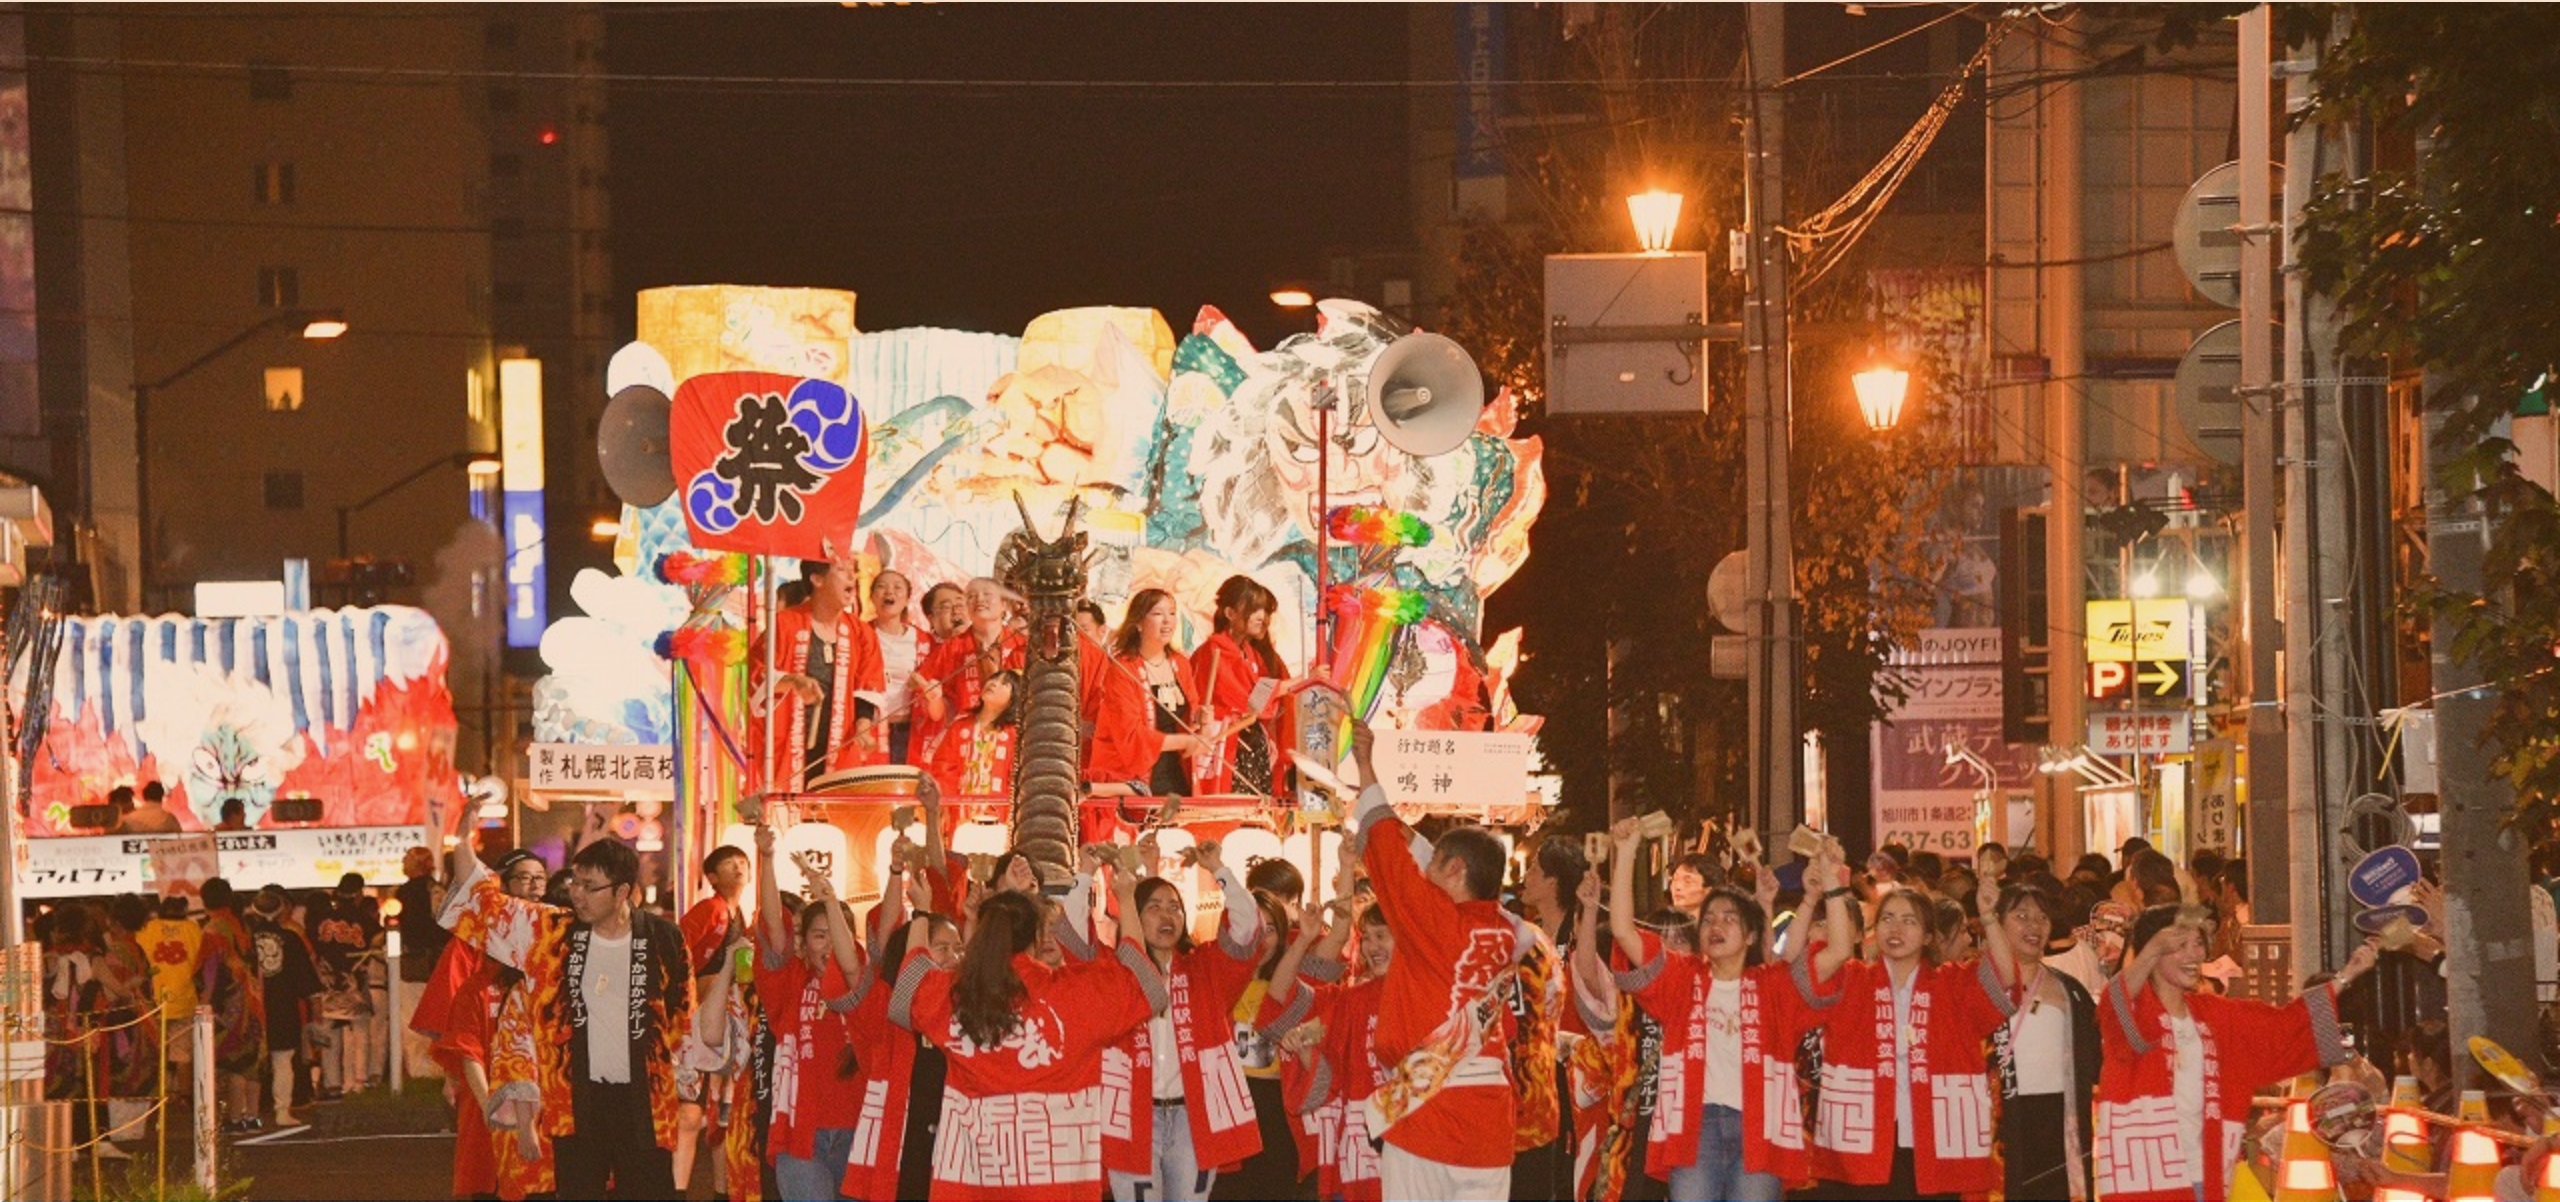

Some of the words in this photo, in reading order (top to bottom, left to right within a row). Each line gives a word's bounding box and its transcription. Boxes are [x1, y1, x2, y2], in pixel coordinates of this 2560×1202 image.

[713, 391, 831, 526] 祭
[2092, 661, 2124, 698] P
[2105, 716, 2172, 733] 最大料金
[1397, 738, 1455, 755] 行灯題名
[2106, 733, 2172, 750] あります
[539, 748, 554, 785] 製作
[560, 754, 674, 780] 札幌北高校
[1397, 771, 1453, 794] 鳴神
[1874, 986, 1895, 1079] 旭川駅立売
